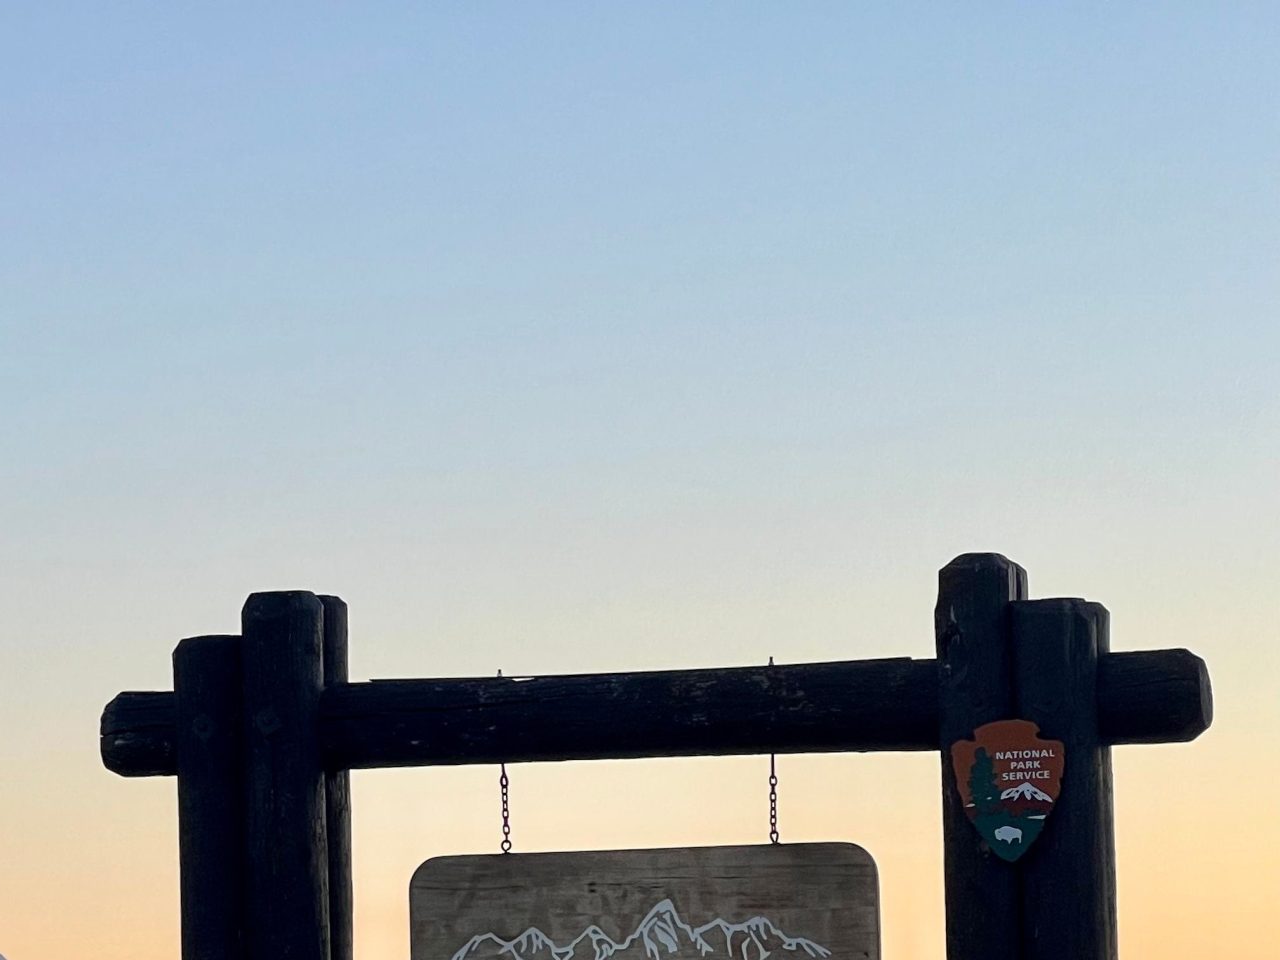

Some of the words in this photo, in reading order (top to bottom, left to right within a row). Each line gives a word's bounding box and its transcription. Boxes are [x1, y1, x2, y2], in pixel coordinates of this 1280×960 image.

[995, 749, 1055, 759] NATIONAL
[1010, 760, 1041, 769] PARK
[1002, 770, 1050, 781] SERVICE
